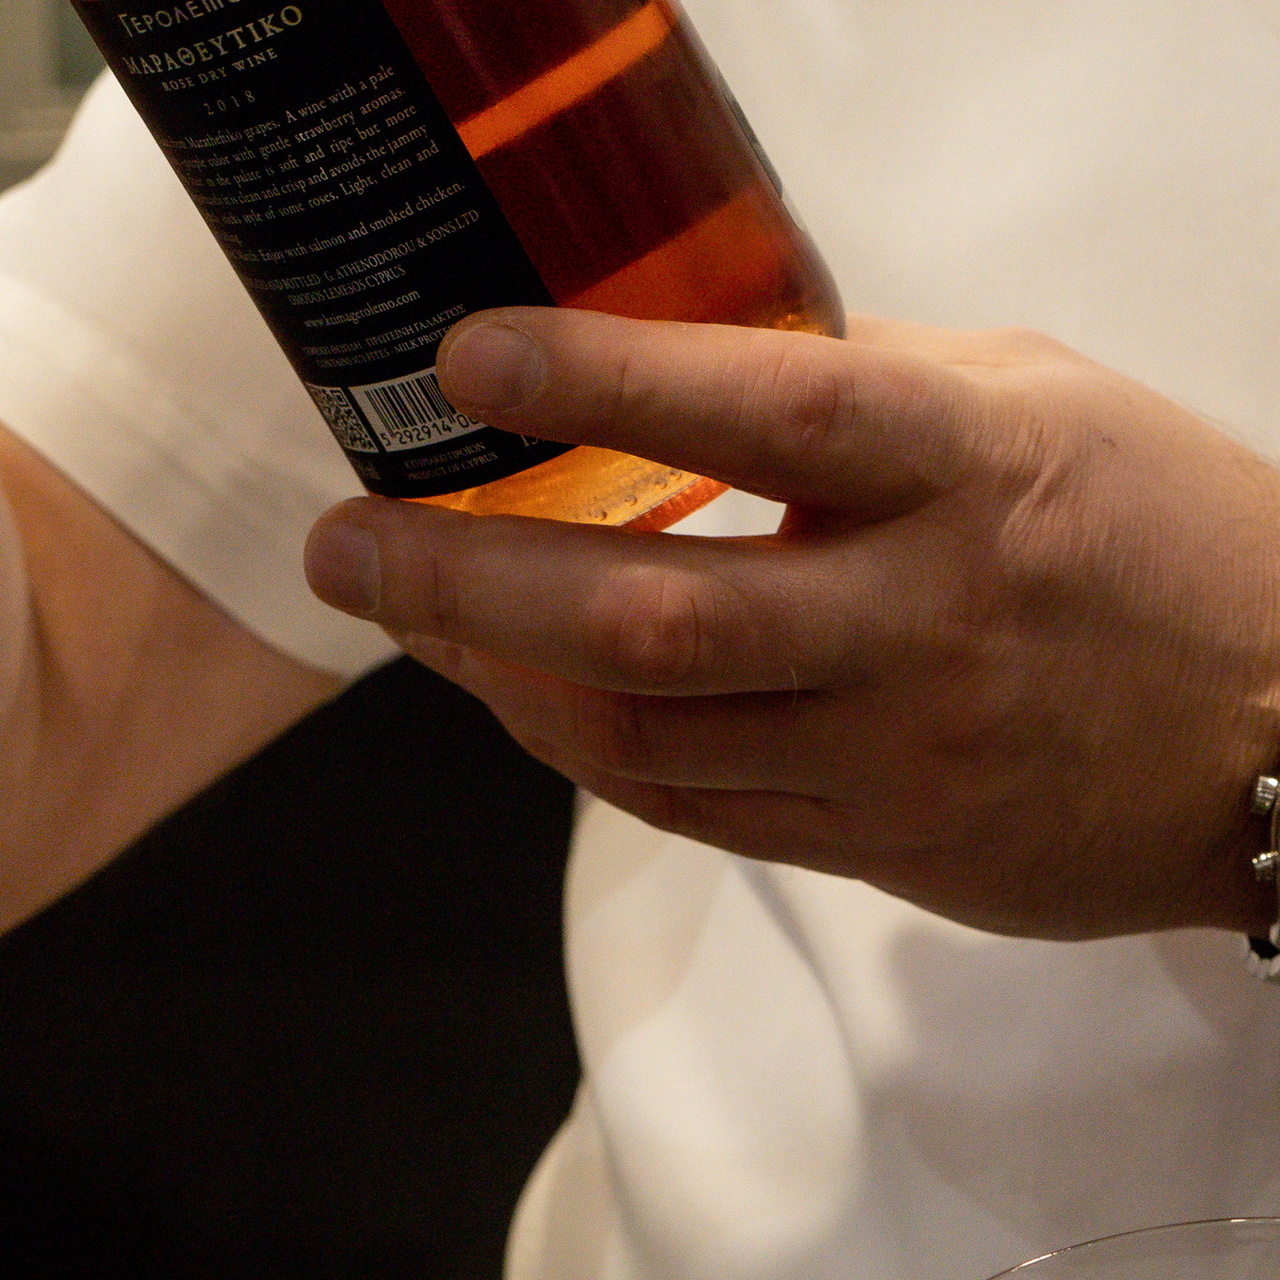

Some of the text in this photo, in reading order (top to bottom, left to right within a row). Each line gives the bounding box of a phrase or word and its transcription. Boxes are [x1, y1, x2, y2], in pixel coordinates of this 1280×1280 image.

[161, 47, 278, 92] ROSE DRY WINE
[243, 120, 281, 142] grapes.
[285, 109, 298, 124] A
[297, 99, 328, 118] wine
[328, 82, 358, 105] with
[359, 80, 368, 91] a
[368, 64, 395, 90] pale
[207, 152, 231, 168] color
[231, 146, 257, 162] with
[258, 135, 292, 160] gentle
[294, 110, 356, 143] strawberry
[359, 86, 406, 116] aromas.
[216, 172, 232, 187] the
[232, 168, 262, 188] palate
[265, 165, 275, 177] is
[278, 154, 300, 173] soft
[303, 143, 326, 165] and
[329, 136, 354, 154] ripe
[355, 123, 381, 141] but
[384, 104, 418, 128] more
[238, 190, 262, 204] clean
[260, 182, 281, 200] and
[280, 178, 307, 194] crisp
[306, 166, 329, 187] and
[328, 152, 367, 178] avoids
[365, 145, 388, 162] the
[386, 123, 428, 155] jammy
[265, 204, 277, 220] of
[278, 202, 305, 217] some
[307, 191, 340, 209] roses.
[338, 174, 378, 196] Light,
[380, 157, 413, 179] clean
[415, 139, 440, 163] and
[258, 248, 287, 264] Enjoy
[284, 241, 309, 258] with
[307, 233, 347, 254] salmon
[346, 221, 369, 241] and
[368, 201, 415, 232] smoked
[415, 182, 466, 212] chicken.
[335, 239, 417, 280] ATHENODOROU
[416, 236, 428, 249] &
[425, 220, 457, 244] SONS
[454, 208, 480, 231] LTD
[323, 278, 367, 301] LEMESOS
[364, 263, 407, 288] CYPRUS
[393, 339, 419, 354] MILK
[417, 324, 453, 347] PROTE
[379, 433, 391, 447] 5
[397, 417, 452, 445] 292914
[407, 450, 499, 481] PRODUCT OF CYPRUS
